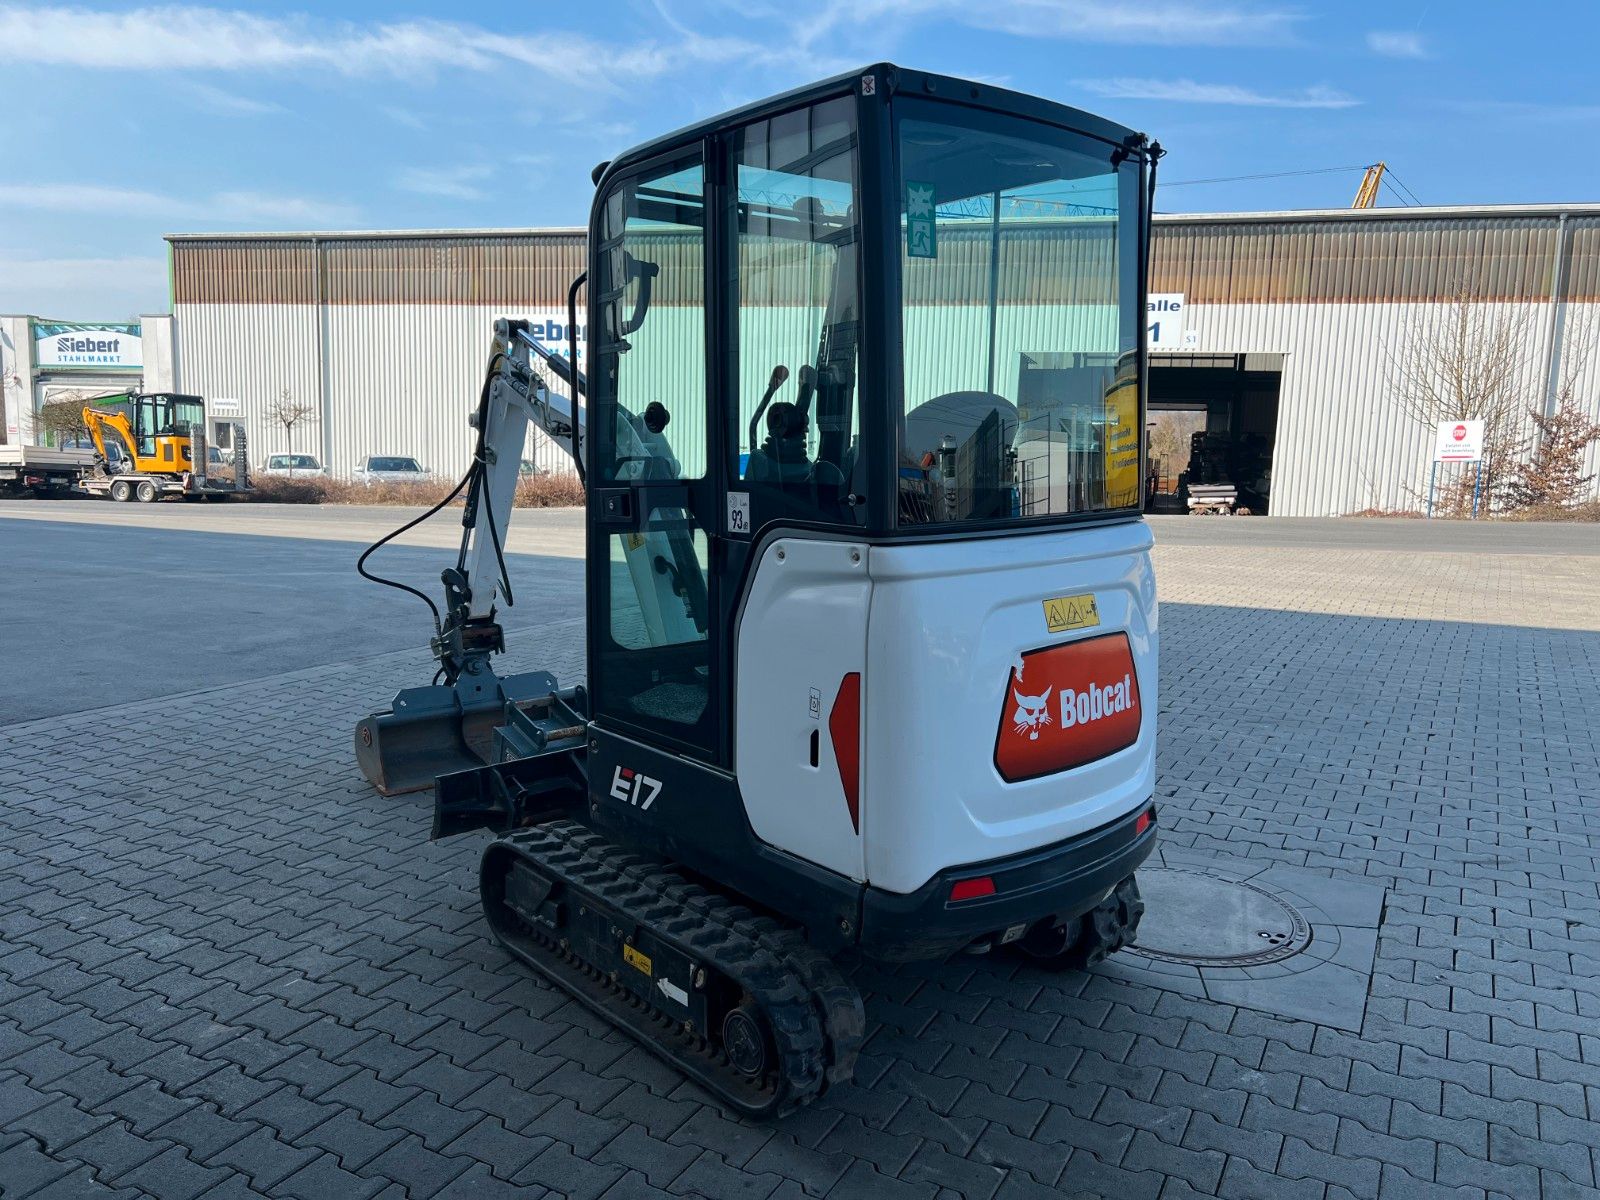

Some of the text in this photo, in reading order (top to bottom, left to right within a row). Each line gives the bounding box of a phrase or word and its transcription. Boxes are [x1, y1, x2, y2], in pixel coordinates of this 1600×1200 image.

[1147, 300, 1181, 311] alle
[1147, 321, 1160, 342] 1
[57, 337, 119, 352] Siebert
[58, 355, 121, 363] STAHLMARKT
[732, 509, 743, 530] 93
[1060, 673, 1132, 730] Bobcat
[609, 765, 663, 810] E17
